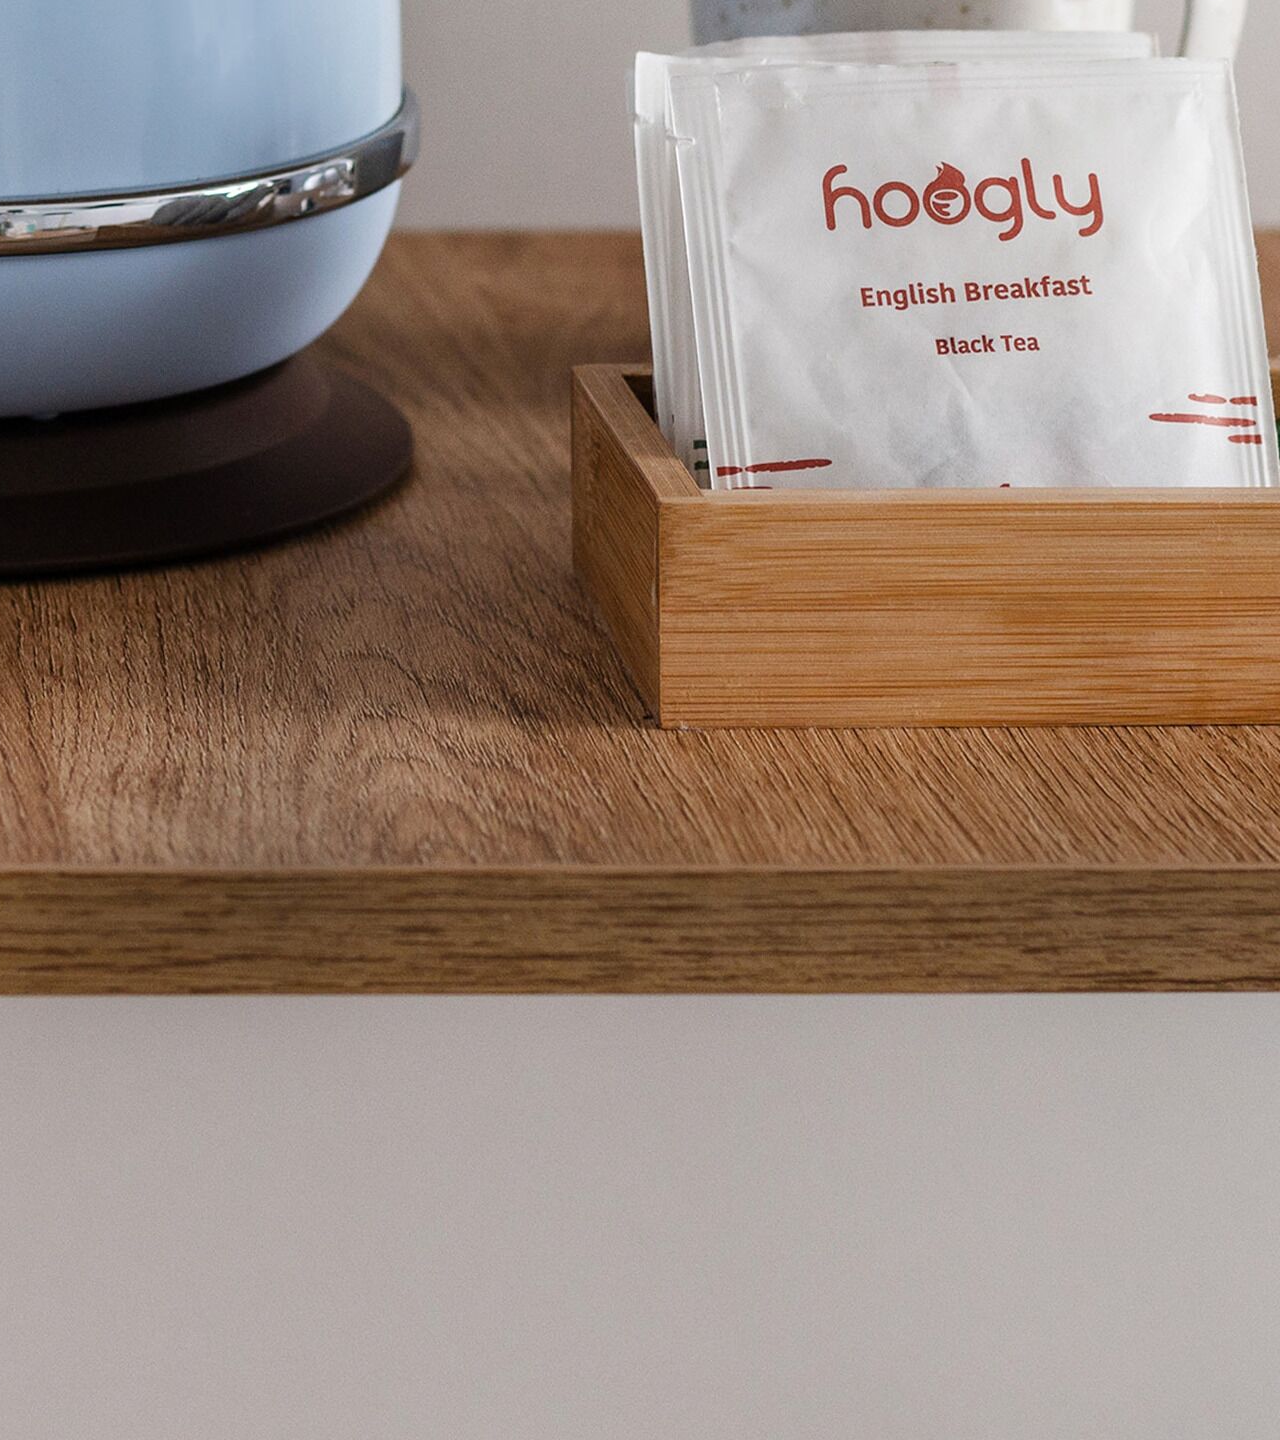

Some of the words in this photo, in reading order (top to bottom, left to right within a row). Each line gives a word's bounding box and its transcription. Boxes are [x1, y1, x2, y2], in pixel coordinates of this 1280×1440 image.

[822, 157, 1104, 241] hoogly
[860, 282, 956, 310] English
[964, 275, 1092, 303] Breakfast
[935, 334, 995, 355] Black
[1000, 333, 1040, 353] Tea
